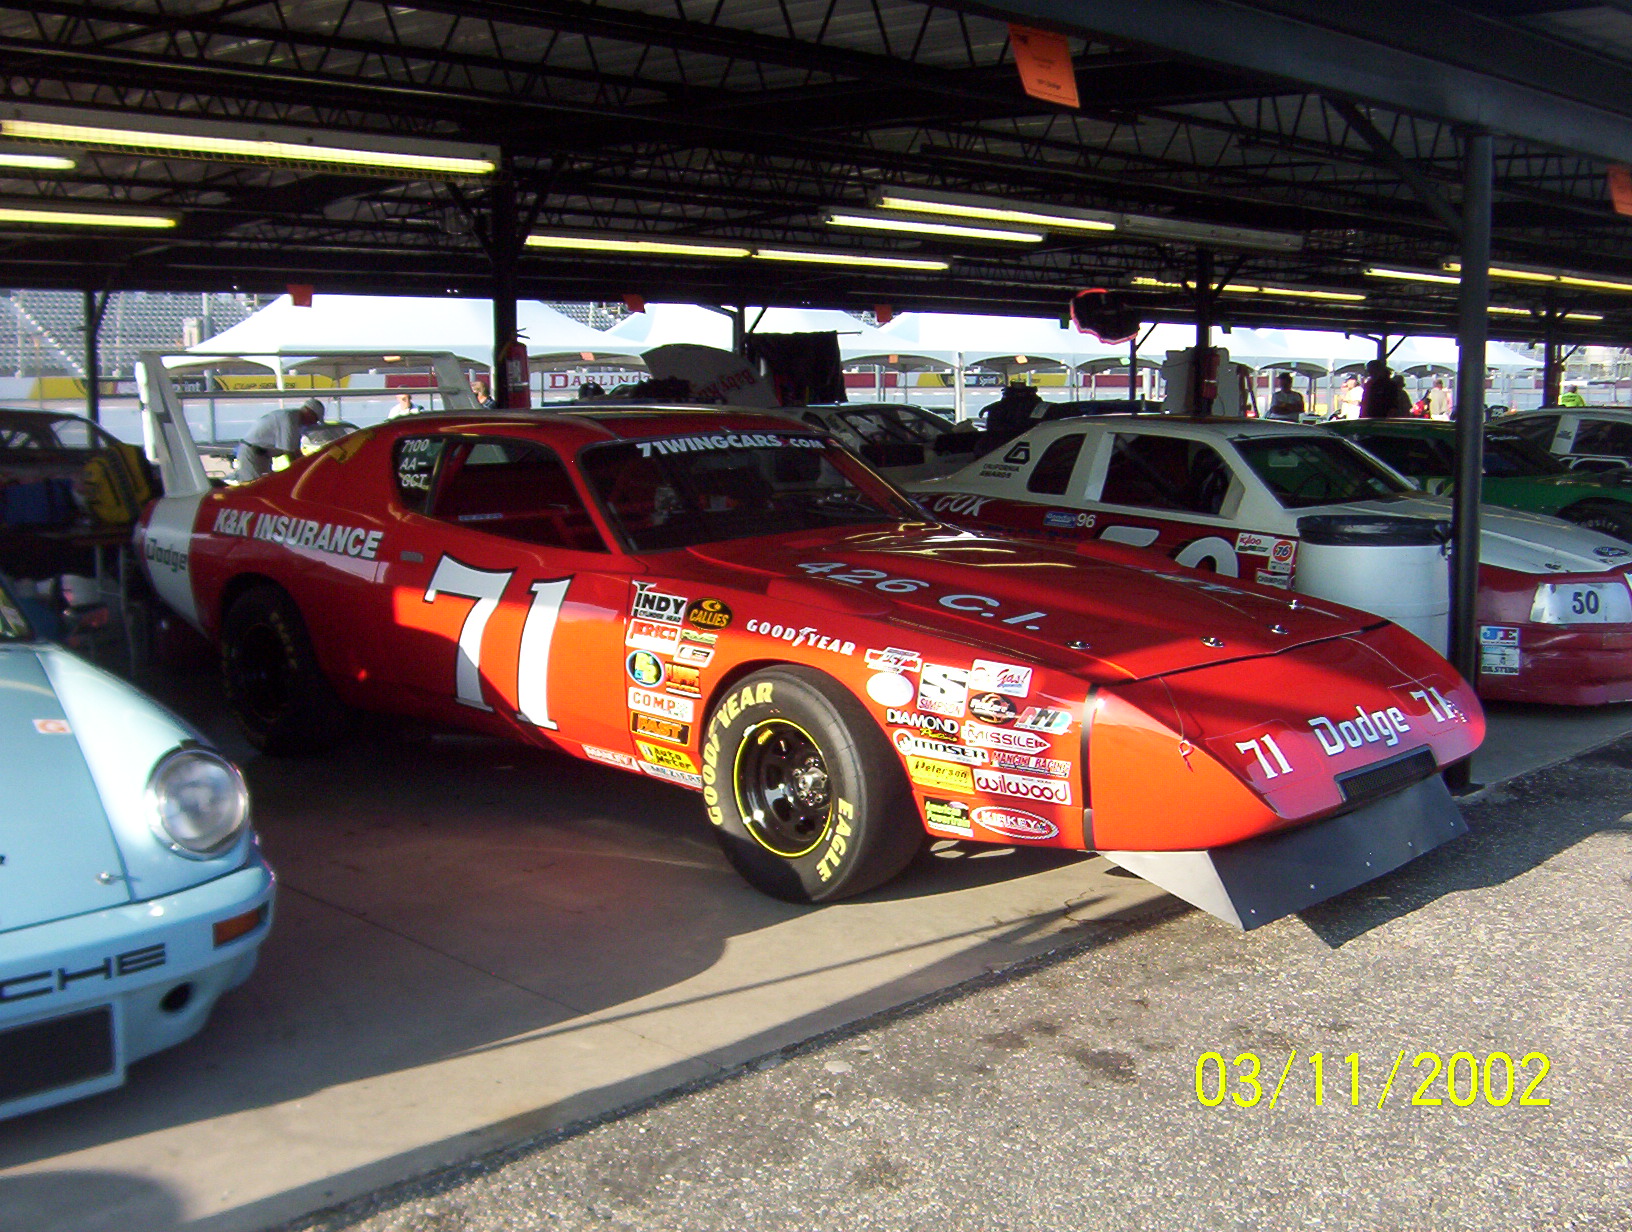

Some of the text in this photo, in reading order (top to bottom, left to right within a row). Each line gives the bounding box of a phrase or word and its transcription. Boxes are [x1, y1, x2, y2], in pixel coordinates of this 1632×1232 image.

[402, 439, 430, 453] 7100
[1077, 512, 1096, 528] 96
[213, 508, 384, 560] K&K INSURANCE
[146, 537, 188, 572] Dodge
[798, 561, 1048, 631] 426 C.I.
[1572, 590, 1600, 615] 50
[689, 607, 729, 627] CALLIES
[423, 551, 576, 732] 71
[633, 691, 676, 711] COMP
[886, 708, 960, 734] DIAMOND
[1308, 686, 1458, 757] Dodge 71
[967, 729, 1037, 749] MISSILE
[1235, 733, 1294, 780] 71
[976, 774, 1068, 803] wilwood
[980, 810, 1038, 830] KIRKEY
[815, 797, 854, 883] EAGLE
